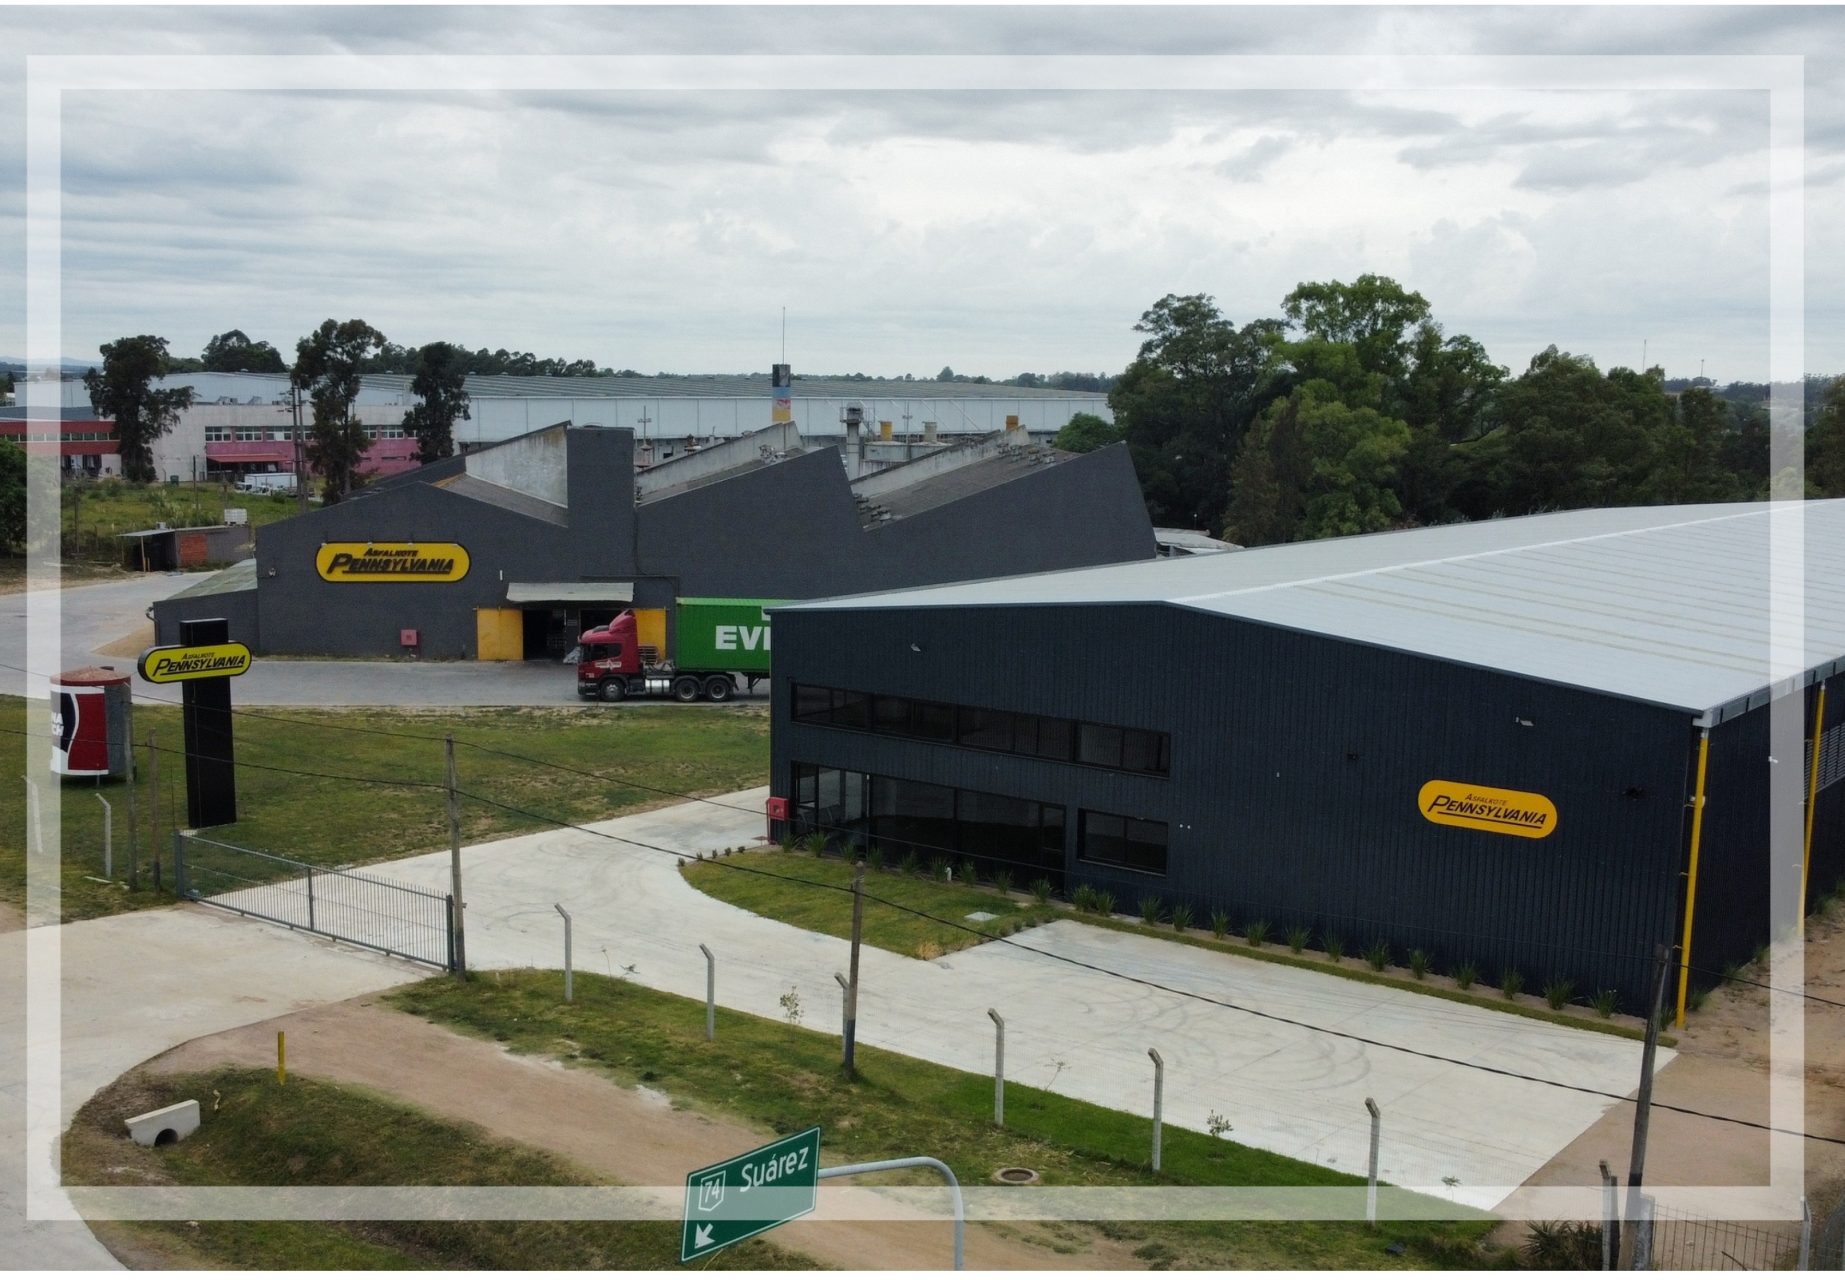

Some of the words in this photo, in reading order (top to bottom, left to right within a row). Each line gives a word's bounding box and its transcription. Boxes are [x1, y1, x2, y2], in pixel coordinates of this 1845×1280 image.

[326, 553, 455, 575] PENNSYLVANIA
[152, 655, 246, 677] PENNSYLVANIA
[1427, 794, 1547, 825] PENNSYLVANIA
[704, 1177, 720, 1204] 74
[740, 1146, 809, 1193] Suárez
